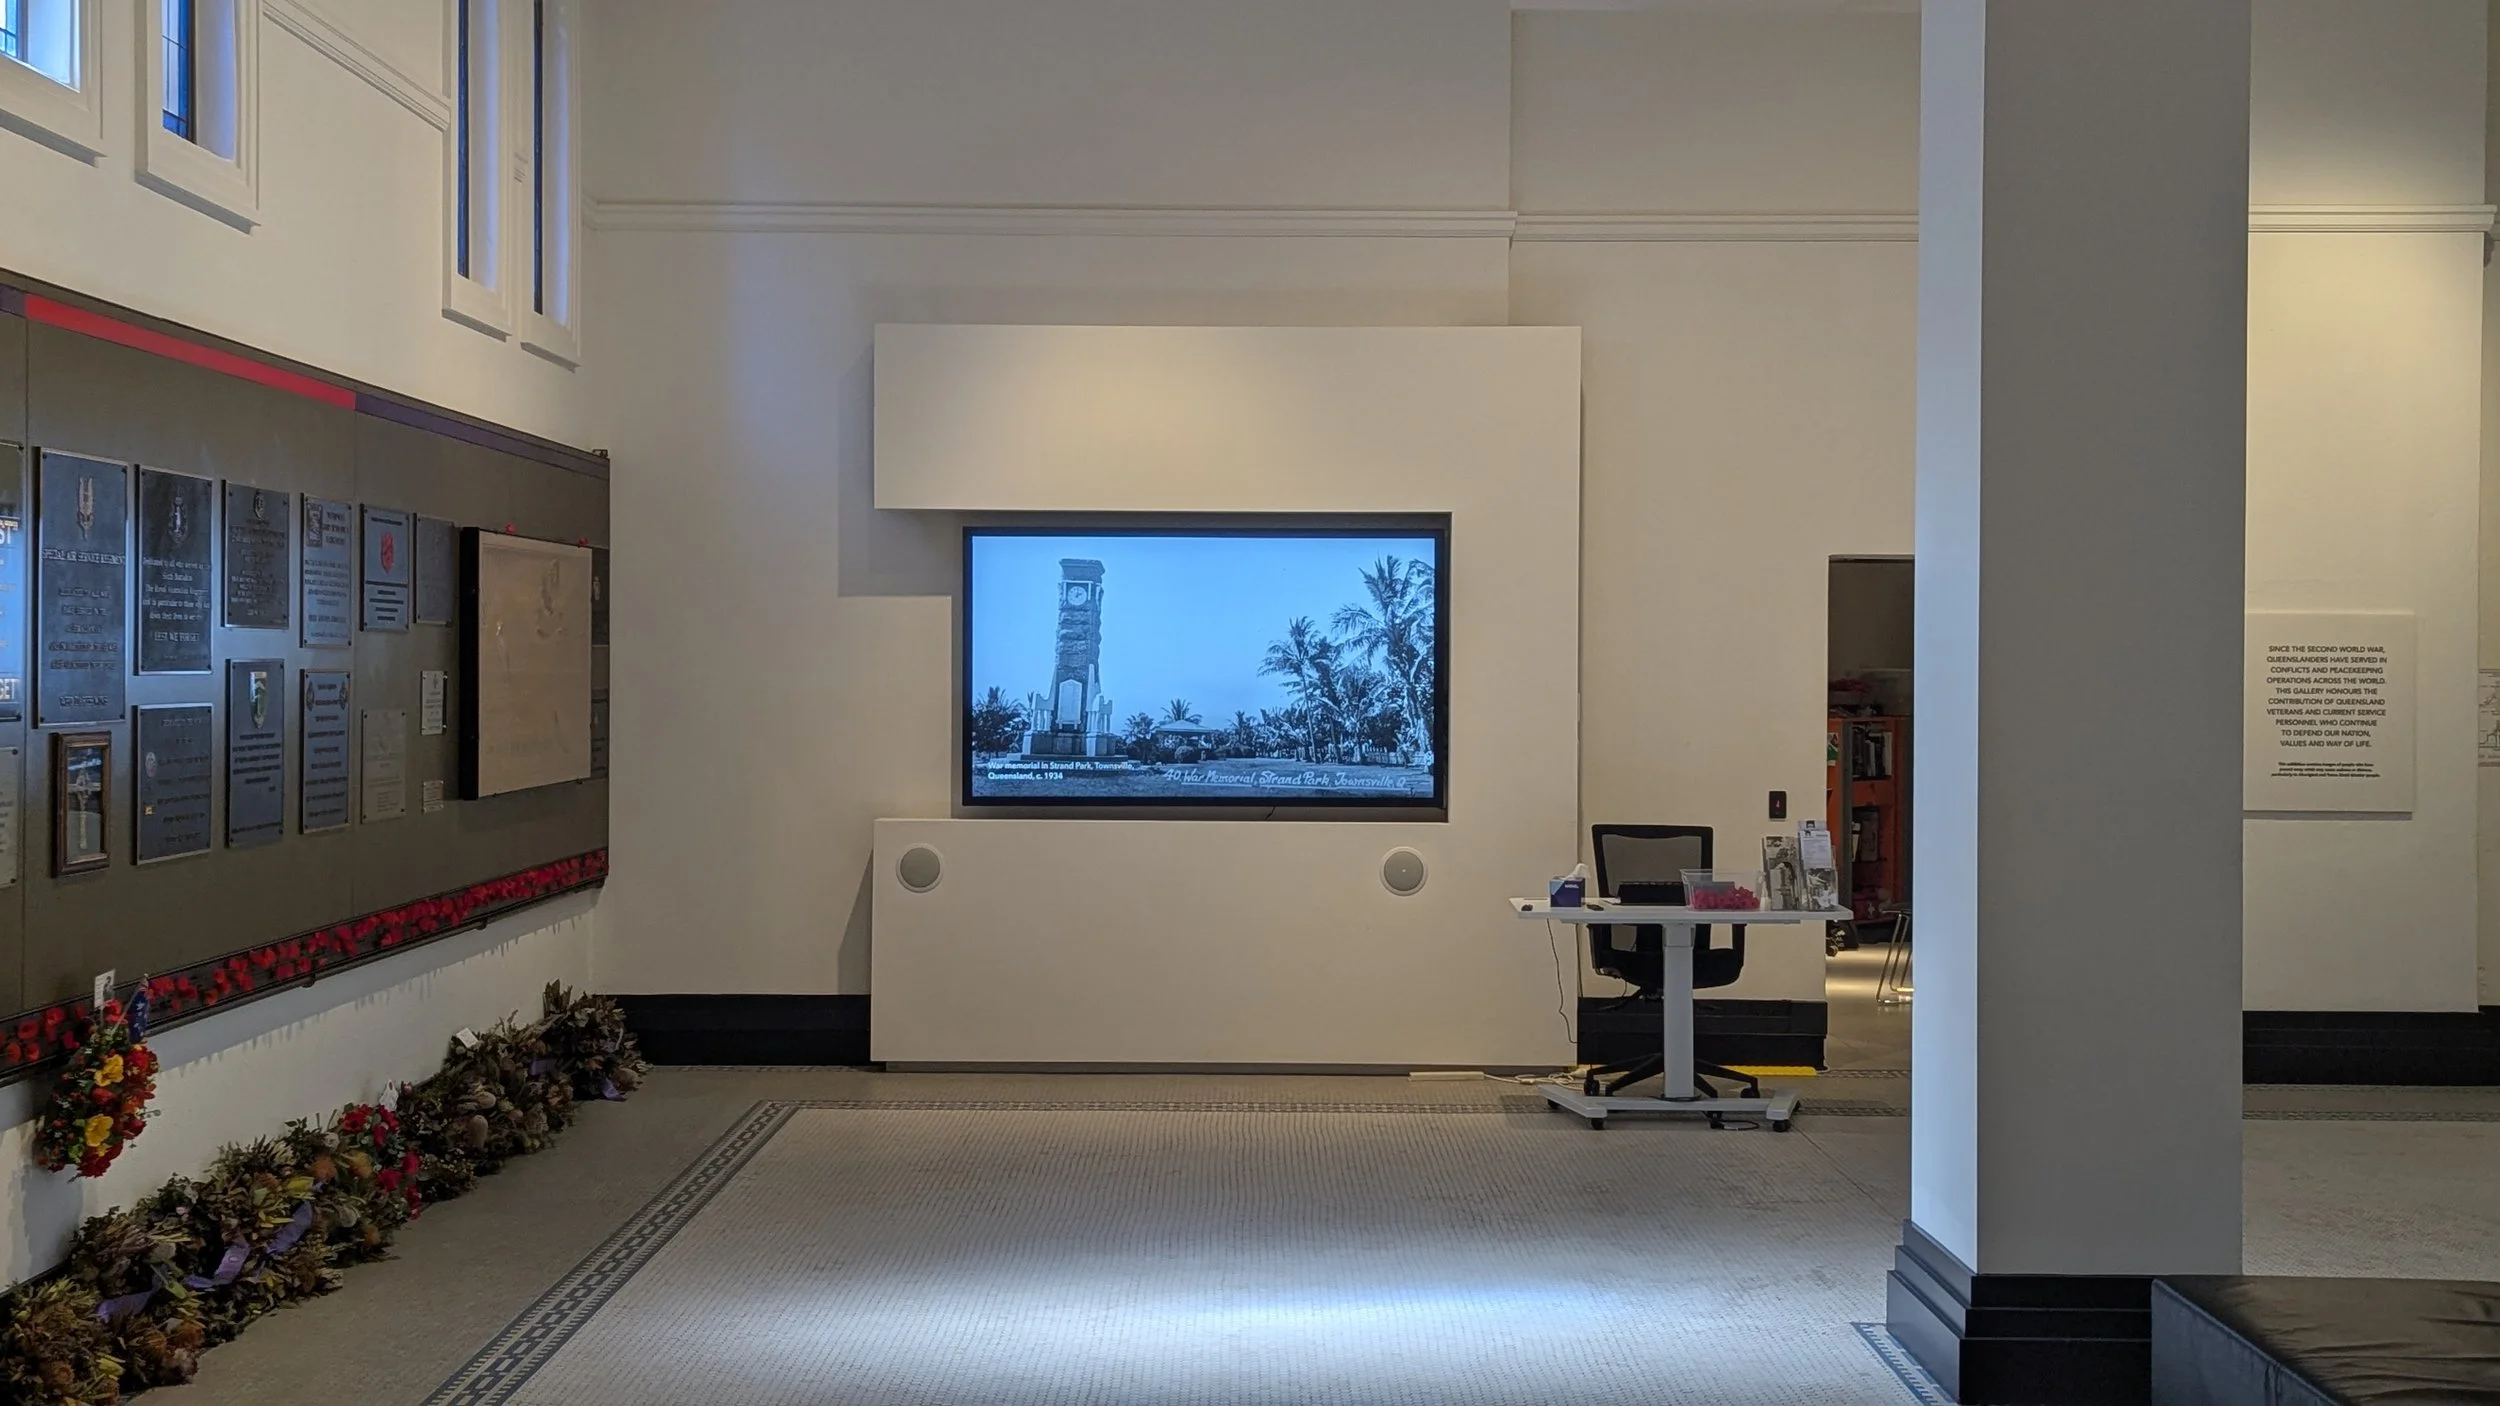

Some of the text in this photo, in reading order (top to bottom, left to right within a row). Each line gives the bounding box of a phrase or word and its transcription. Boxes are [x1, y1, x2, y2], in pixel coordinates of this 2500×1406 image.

[2268, 645, 2290, 653] SINCE
[2292, 645, 2306, 653] THE
[2307, 645, 2338, 653] SECOND
[2339, 645, 2366, 653] WORLD
[2266, 656, 2388, 664] QUEENSLANDERS HAVE SERVED IN
[988, 761, 1135, 771] War memorial in Strand Park, Townsville,
[988, 772, 1035, 781] Queensland,
[1044, 772, 1064, 780] 1934
[1183, 768, 1205, 783] War
[1259, 771, 1302, 785] Strand
